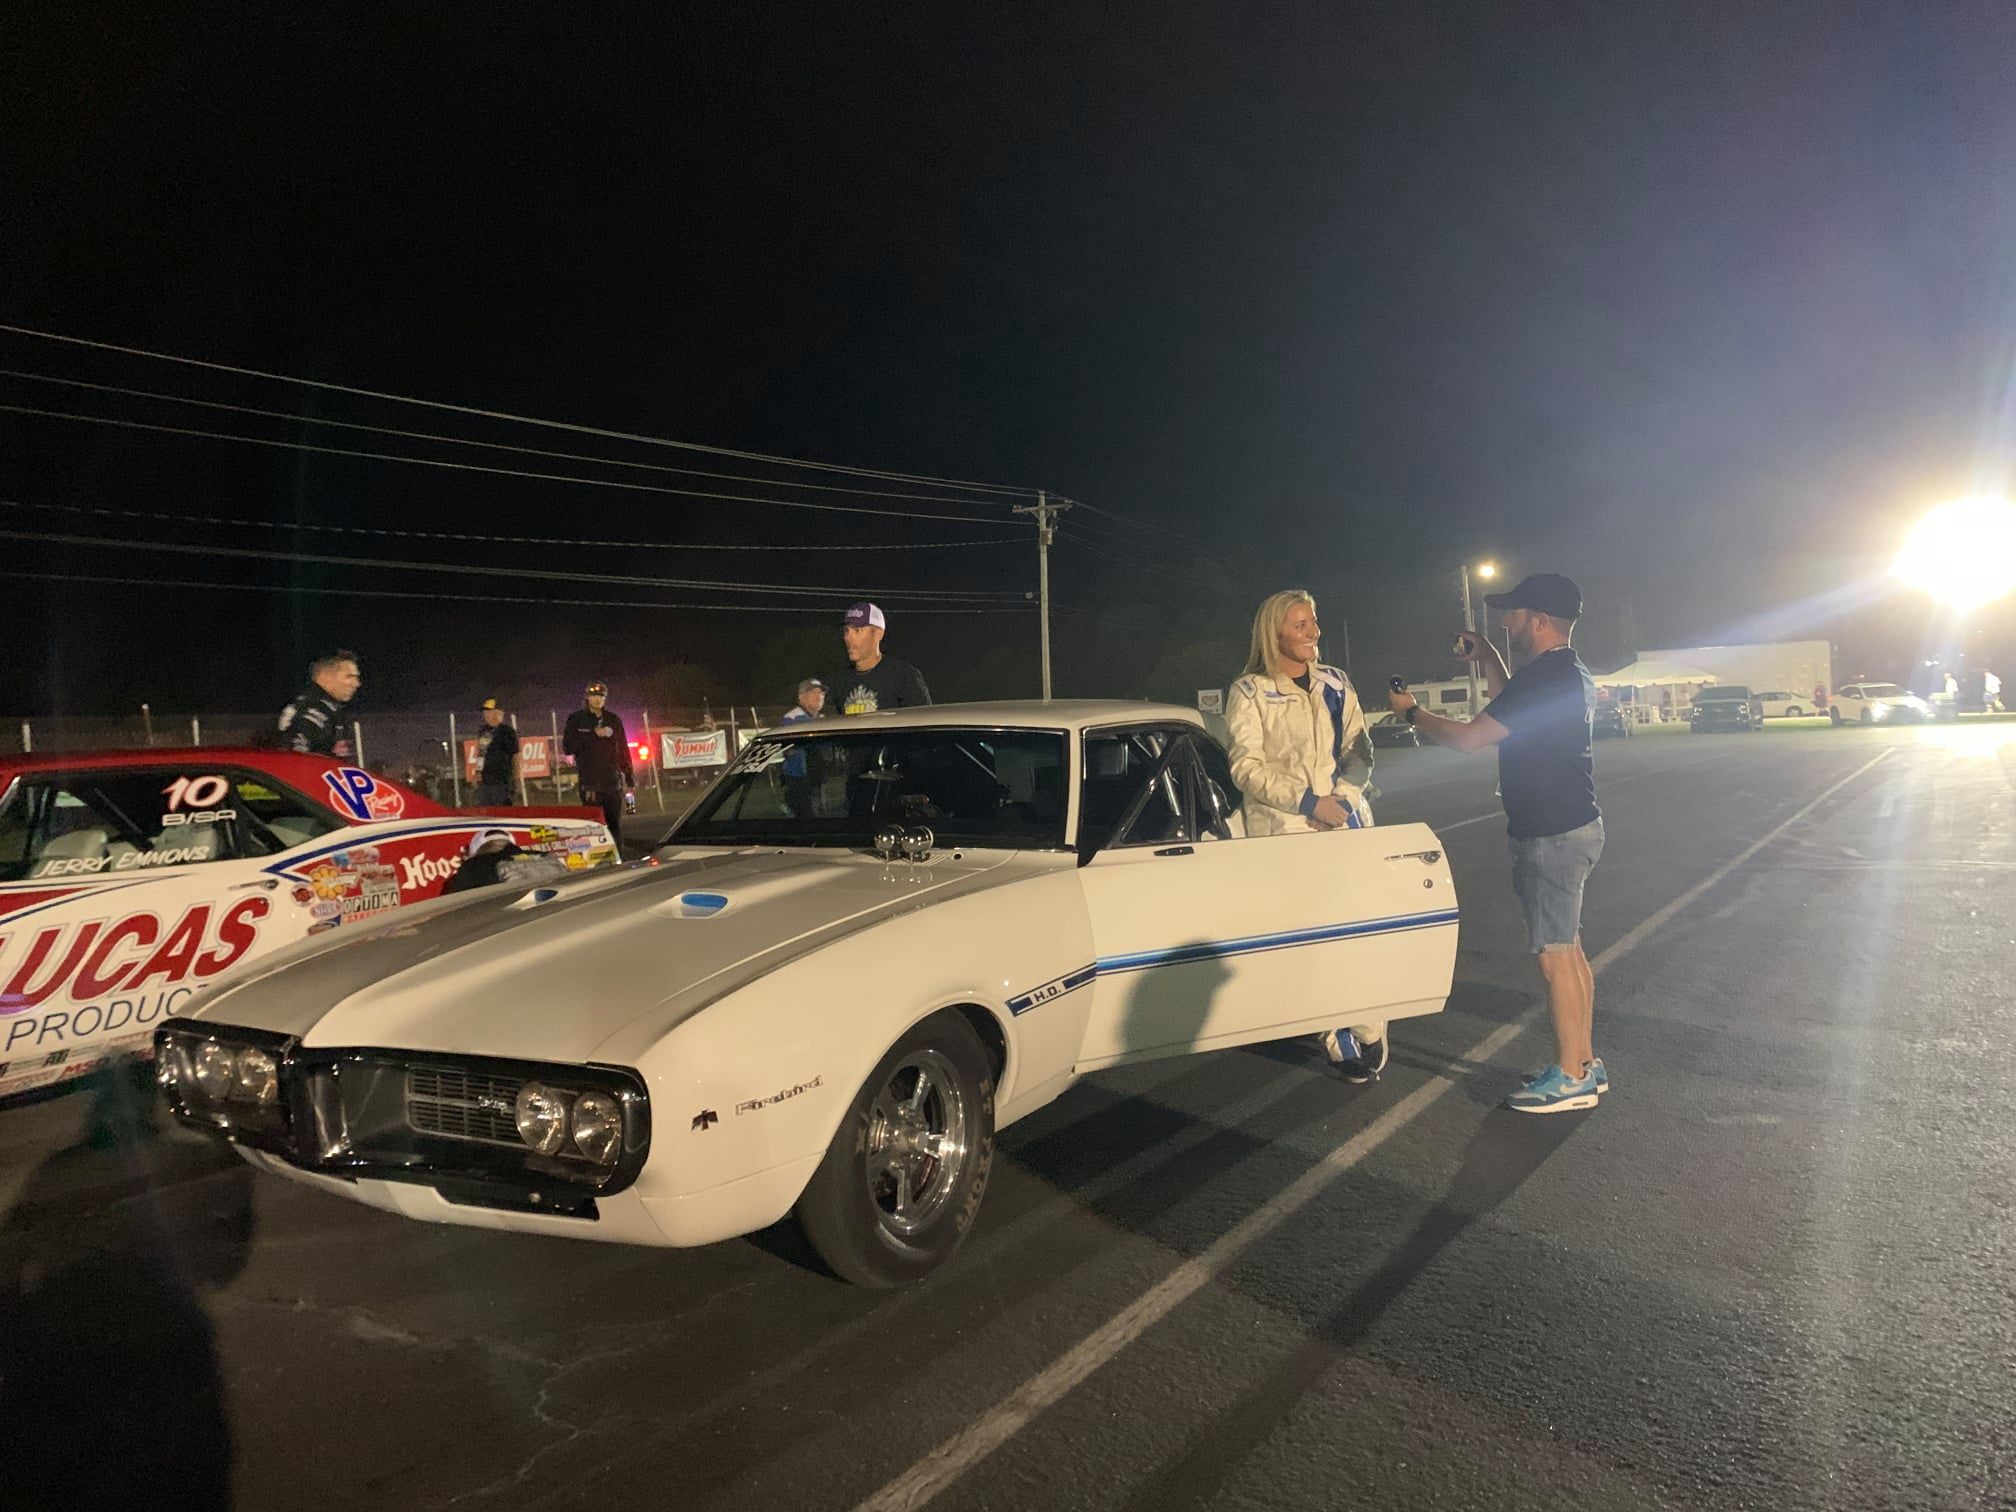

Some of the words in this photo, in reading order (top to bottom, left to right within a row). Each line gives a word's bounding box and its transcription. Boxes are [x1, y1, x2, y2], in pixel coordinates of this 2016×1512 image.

[522, 742, 546, 760] OIL
[673, 736, 717, 763] SUMMIT
[162, 776, 229, 812] 10
[322, 767, 376, 820] VP
[162, 809, 236, 826] B/SA
[35, 857, 112, 878] JERRY
[116, 847, 209, 869] EMMONS
[400, 846, 468, 889] Hoos
[343, 892, 399, 914] OPTIMA
[0, 897, 269, 1016] UCAS
[1033, 985, 1062, 1002] H.D.
[6, 984, 207, 1051] PRODUC
